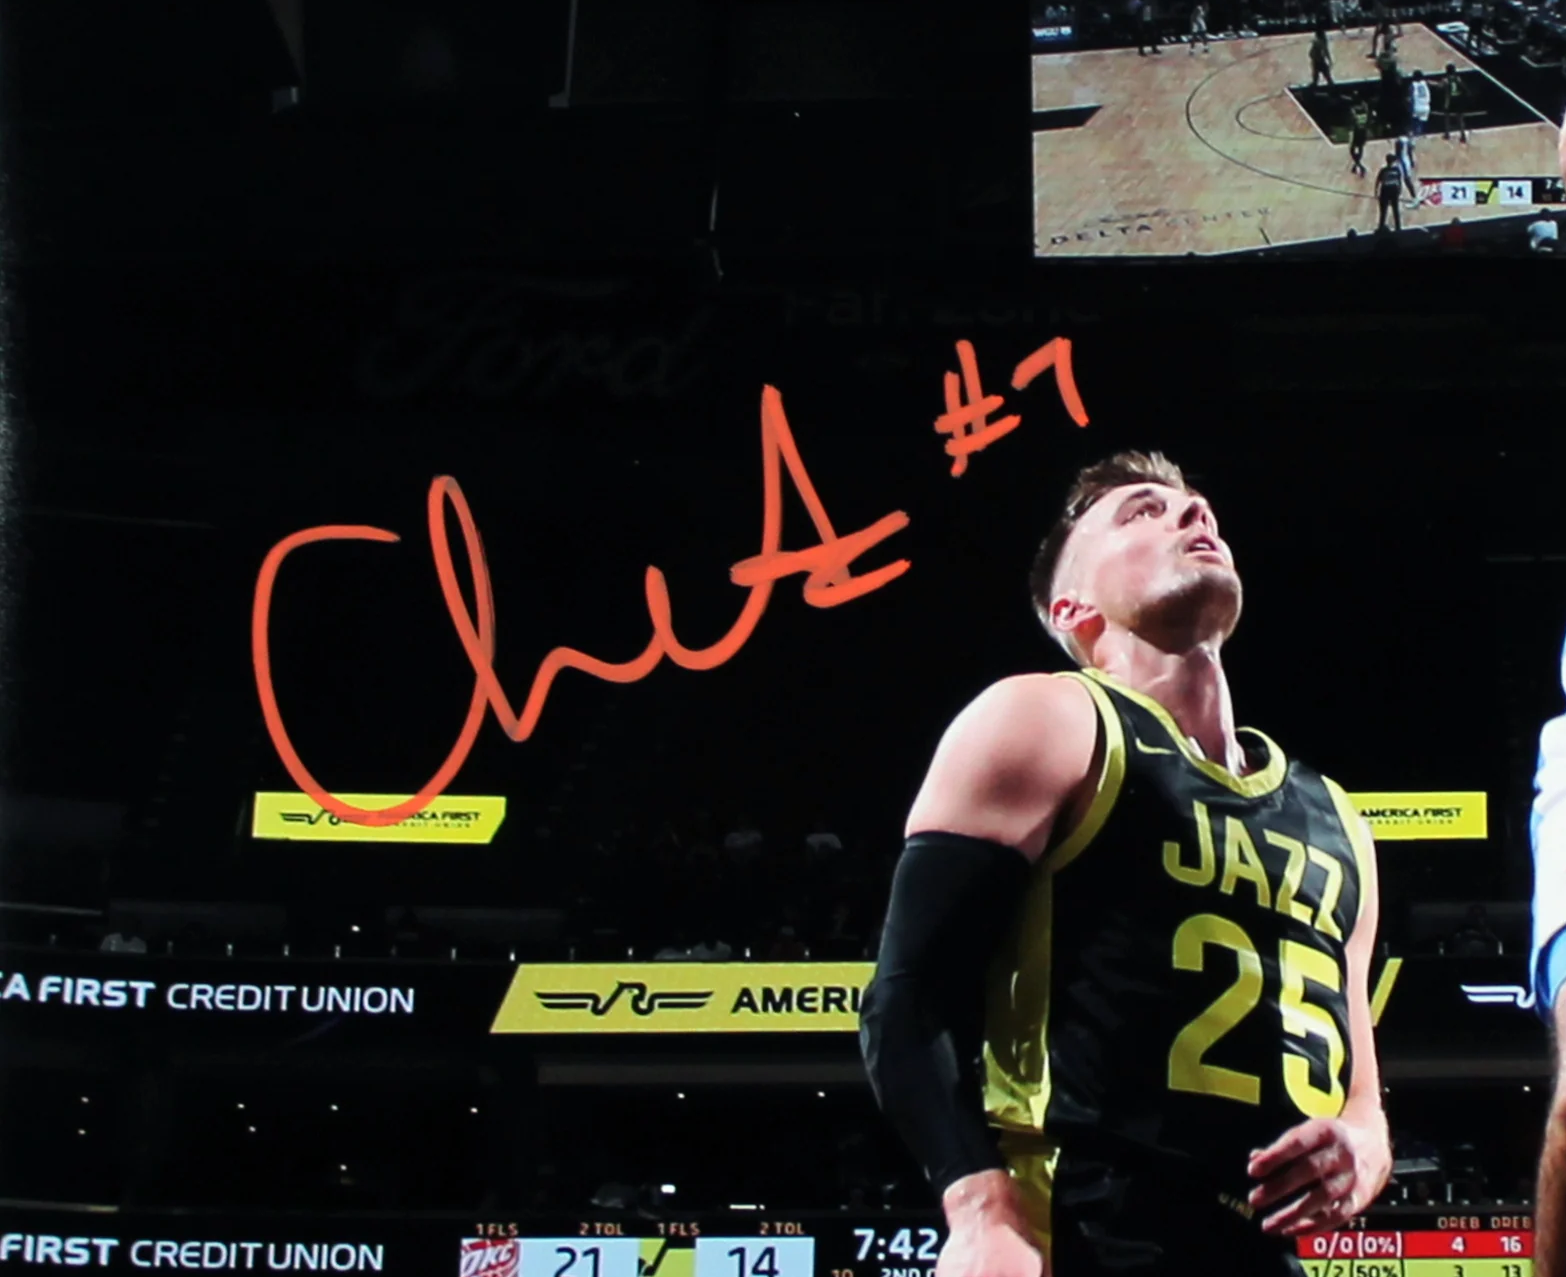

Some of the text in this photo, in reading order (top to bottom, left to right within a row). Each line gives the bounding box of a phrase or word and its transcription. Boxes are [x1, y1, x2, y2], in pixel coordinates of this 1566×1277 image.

[1451, 186, 1467, 200] 21
[1507, 186, 1524, 199] 14
[1361, 806, 1462, 818] AMERICA FIRST
[1163, 799, 1343, 942] JAZZ
[38, 976, 156, 1008] FIRST
[167, 983, 296, 1011] CREDIT
[301, 986, 415, 1013] UNION
[731, 987, 862, 1014] AMERI
[1168, 913, 1346, 1120] 25
[488, 1223, 518, 1236] FLS
[579, 1223, 624, 1235] 2 TOL
[669, 1223, 700, 1236] FLS
[760, 1222, 805, 1235] 2 TOL
[0, 1233, 384, 1271] FIRST CREDIT UNION
[853, 1228, 939, 1262] 7:42
[1451, 1236, 1465, 1253] 4
[1501, 1236, 1522, 1253] 16
